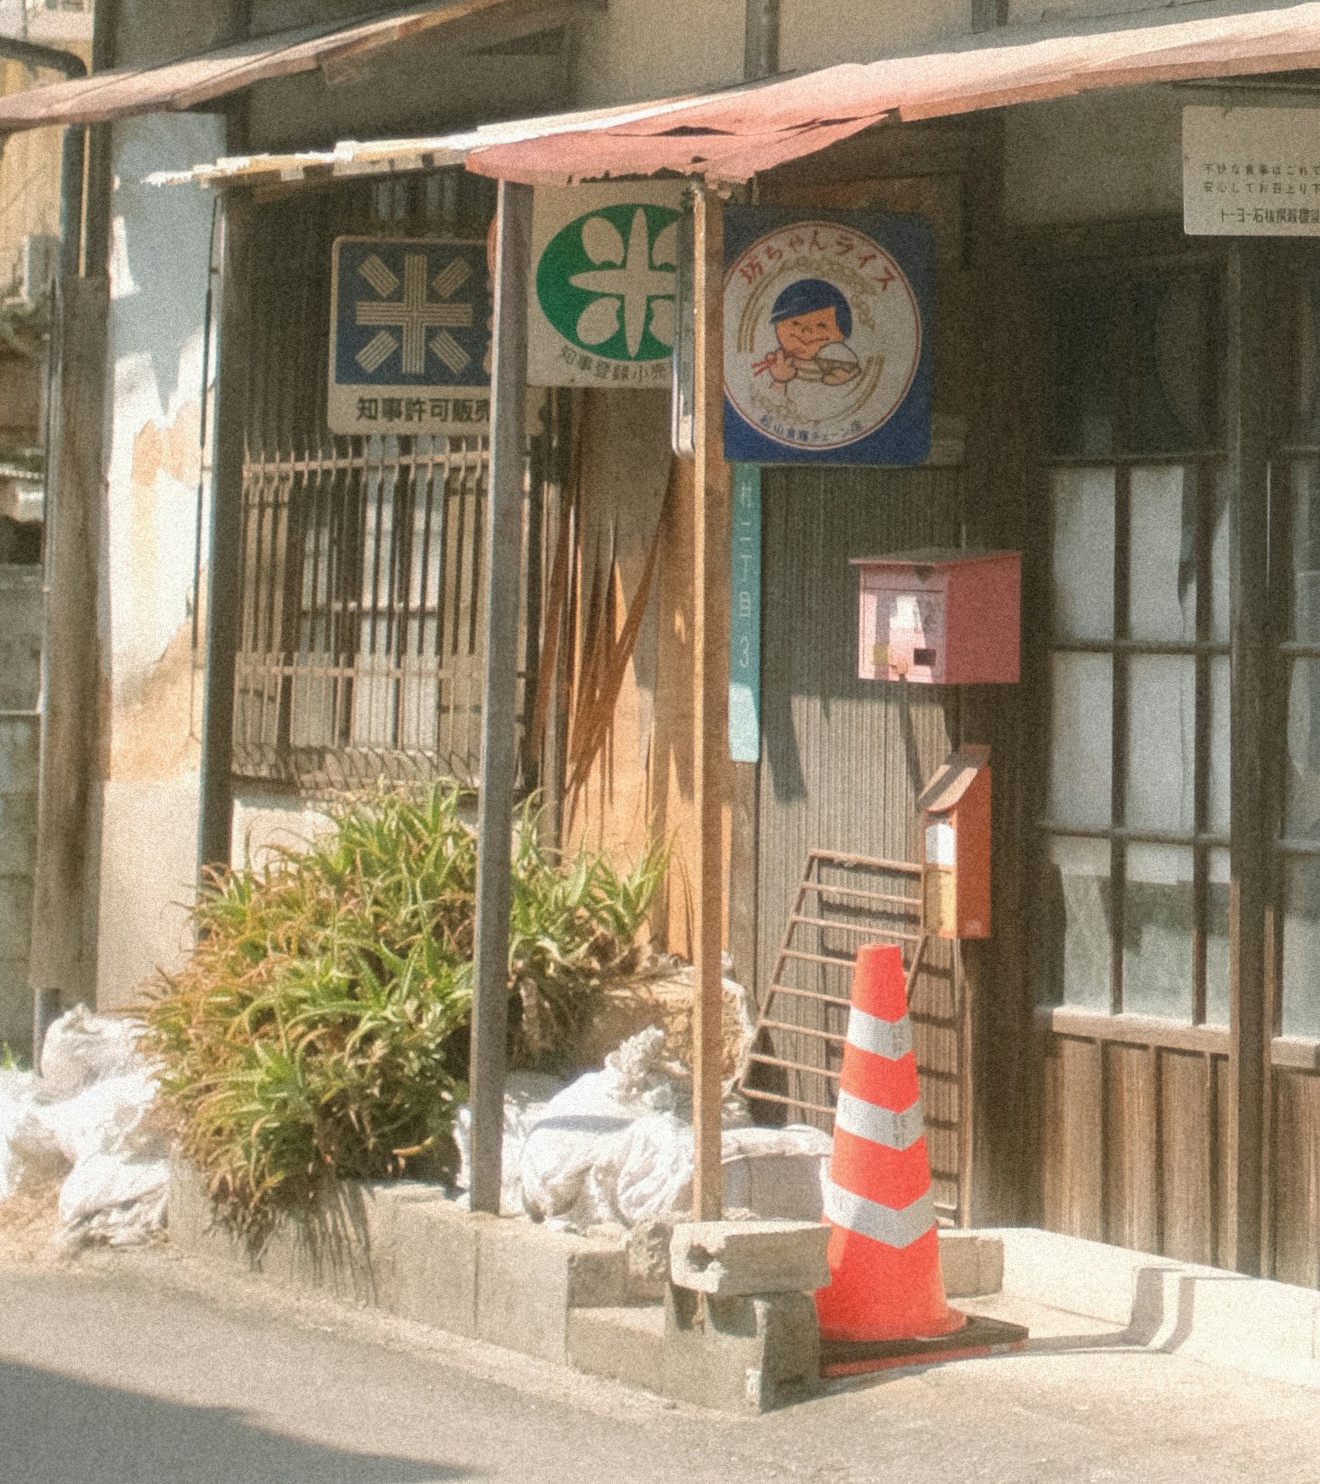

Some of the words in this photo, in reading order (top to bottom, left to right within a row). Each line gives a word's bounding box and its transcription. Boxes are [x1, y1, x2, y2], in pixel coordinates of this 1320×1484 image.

[739, 229, 896, 291] 坊ちゃんライス
[557, 345, 673, 382] 知事登録小売
[356, 396, 490, 423] 知事許可販売
